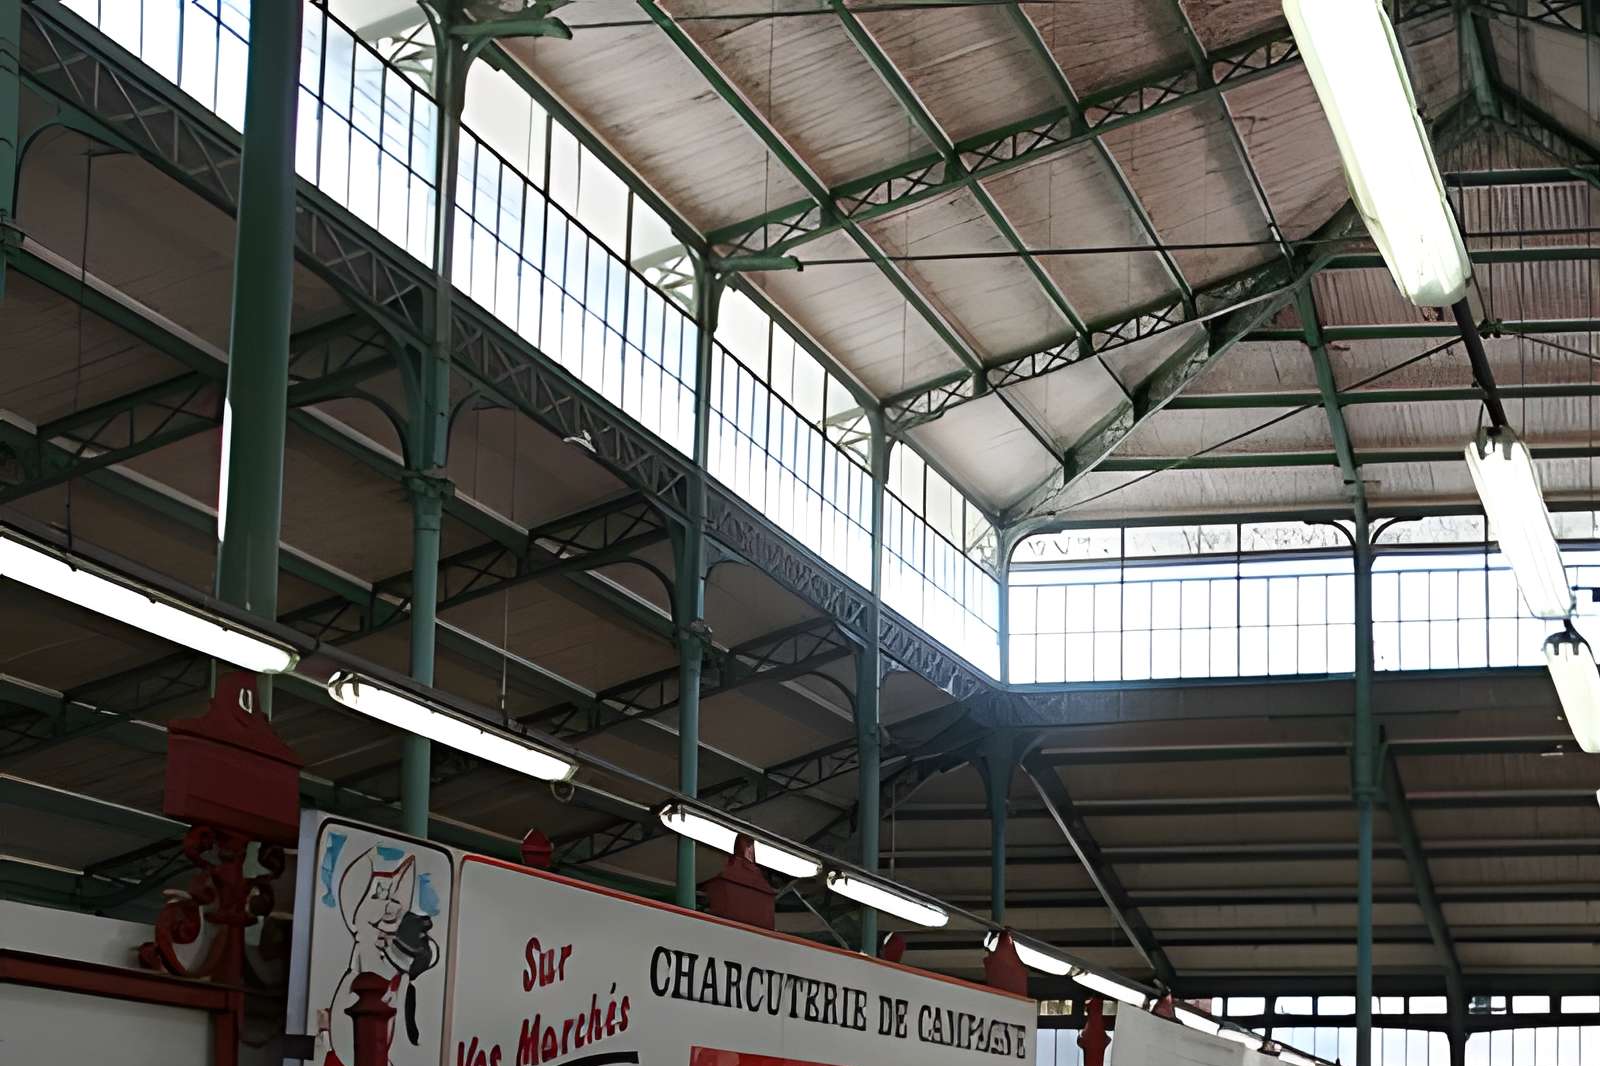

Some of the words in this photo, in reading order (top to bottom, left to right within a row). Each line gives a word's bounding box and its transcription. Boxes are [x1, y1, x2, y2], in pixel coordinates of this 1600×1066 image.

[522, 936, 573, 992] Sur
[650, 945, 868, 1032] CHARCUTERIE
[878, 995, 908, 1038] DE
